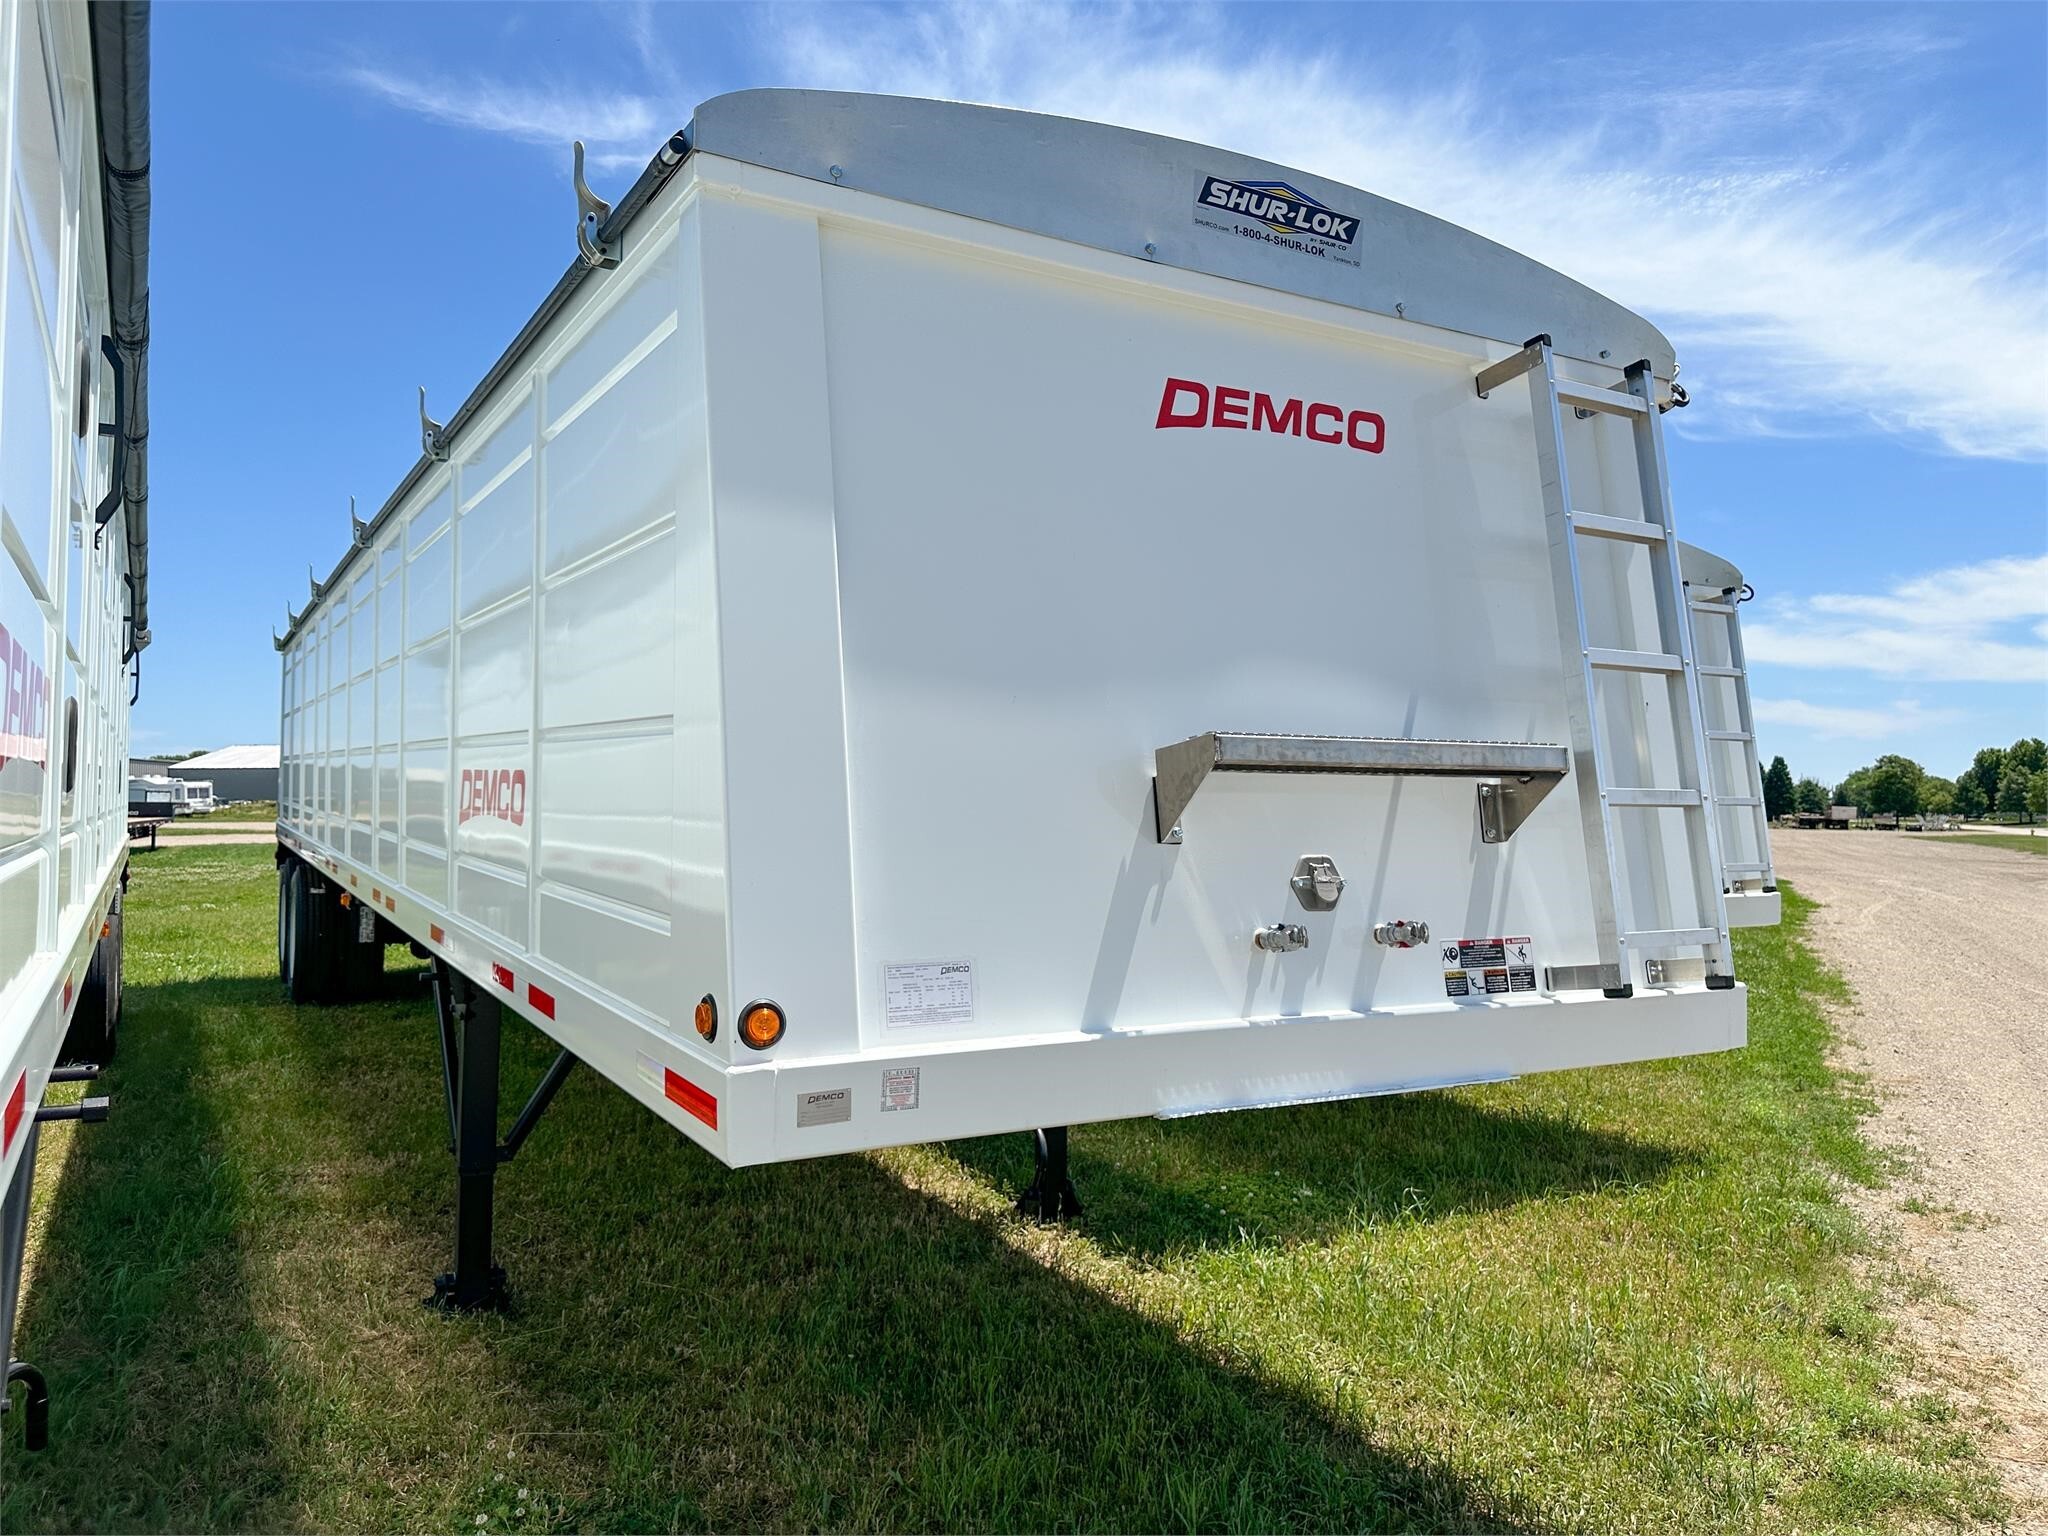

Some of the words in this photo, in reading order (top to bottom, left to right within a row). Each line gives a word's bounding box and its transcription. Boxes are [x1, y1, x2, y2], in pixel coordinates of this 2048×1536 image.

[1206, 181, 1353, 240] SHUR-LOK
[1233, 225, 1326, 257] 1-800-4-SHUR-LOK
[1155, 377, 1385, 454] DEMCO
[458, 769, 526, 827] DEMCO
[940, 965, 970, 976] DEMCO
[807, 1092, 845, 1105] DEMCO
